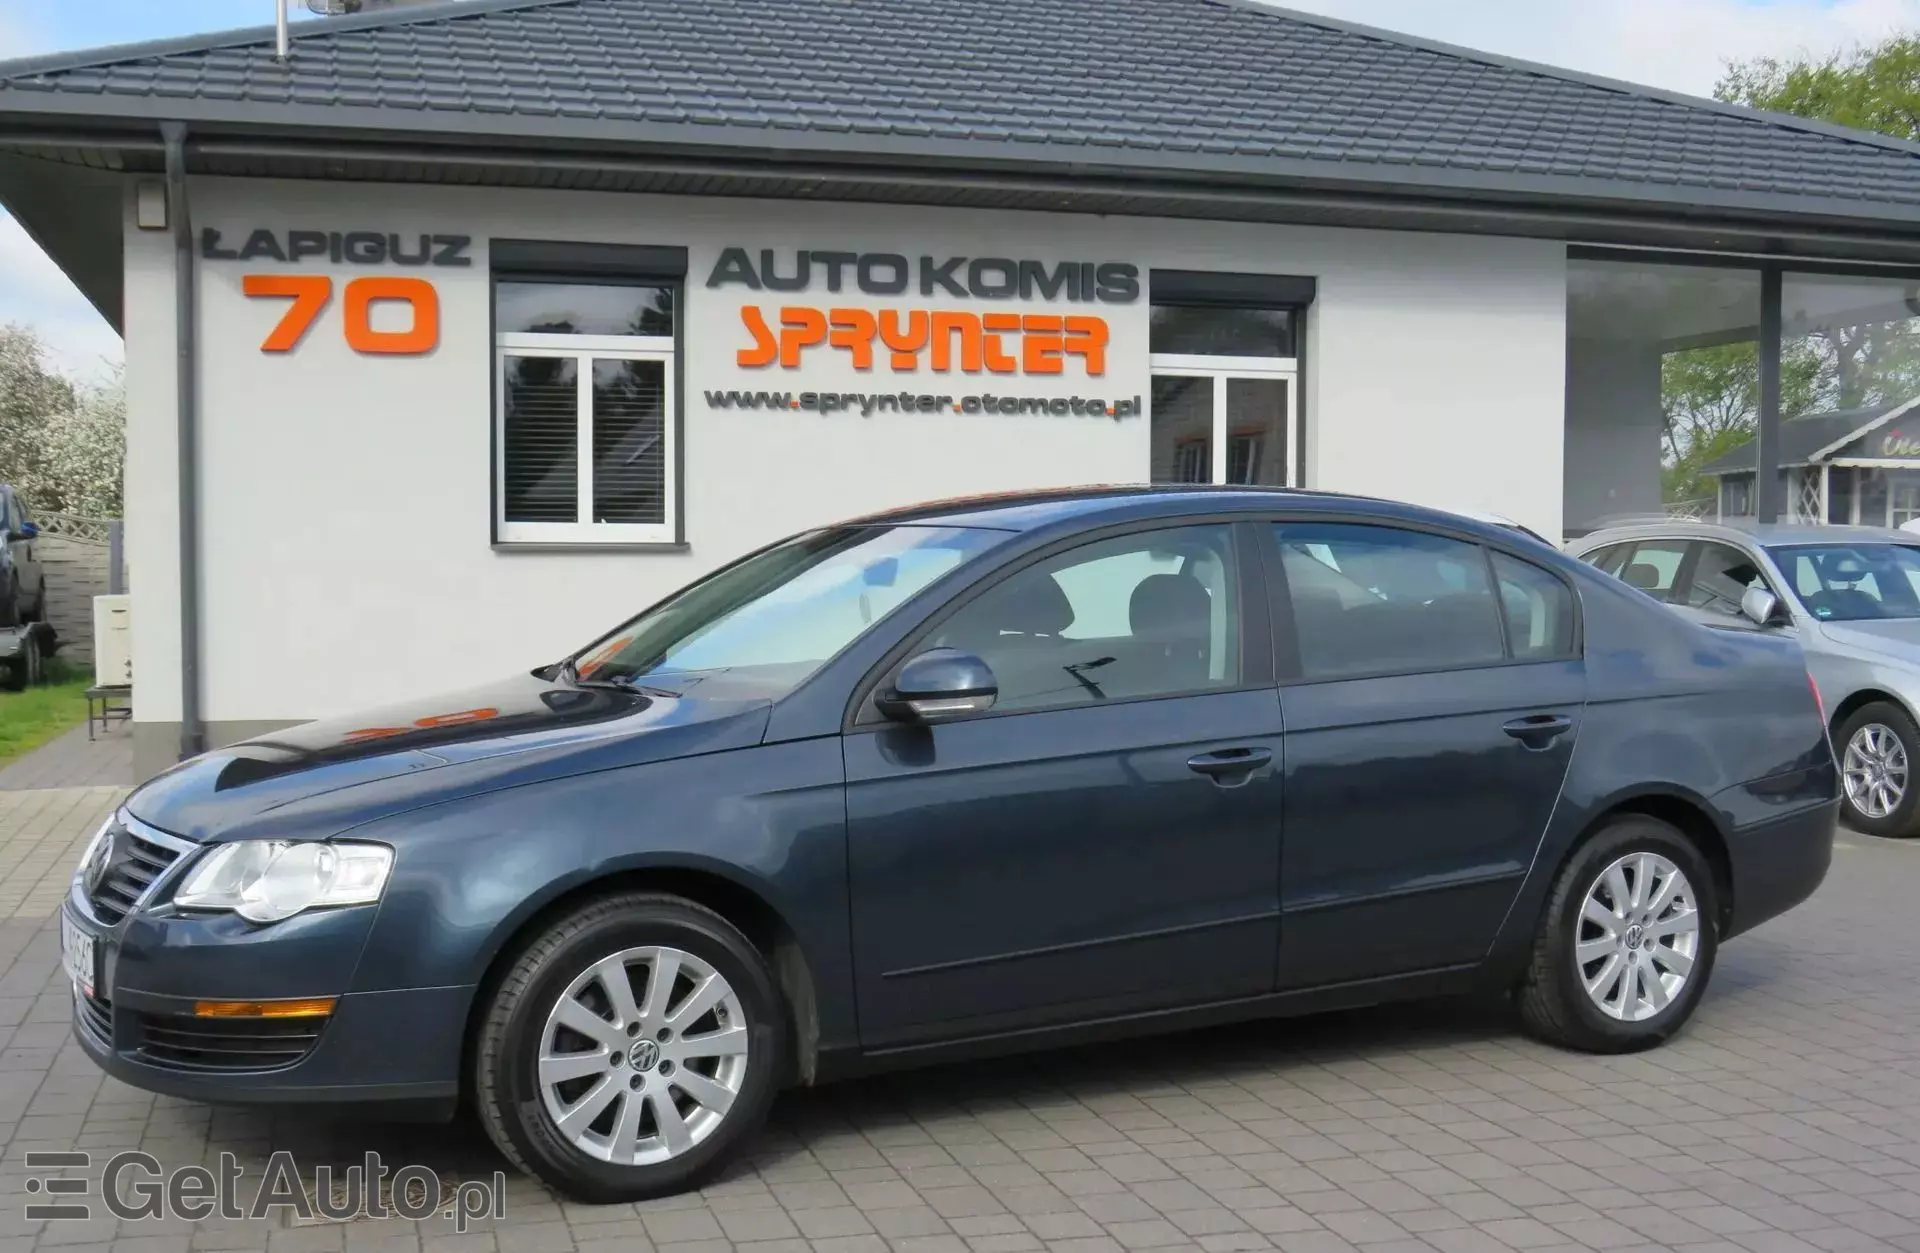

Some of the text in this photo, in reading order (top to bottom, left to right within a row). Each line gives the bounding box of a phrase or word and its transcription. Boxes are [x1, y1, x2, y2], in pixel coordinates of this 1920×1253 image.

[202, 227, 472, 267] ŁAPIGUZ
[706, 247, 1140, 303] AUTO KOMIS
[242, 274, 439, 354] 70
[736, 305, 1110, 376] SPRYNTER
[703, 389, 1142, 422] www.sprynter.otomoto.pl
